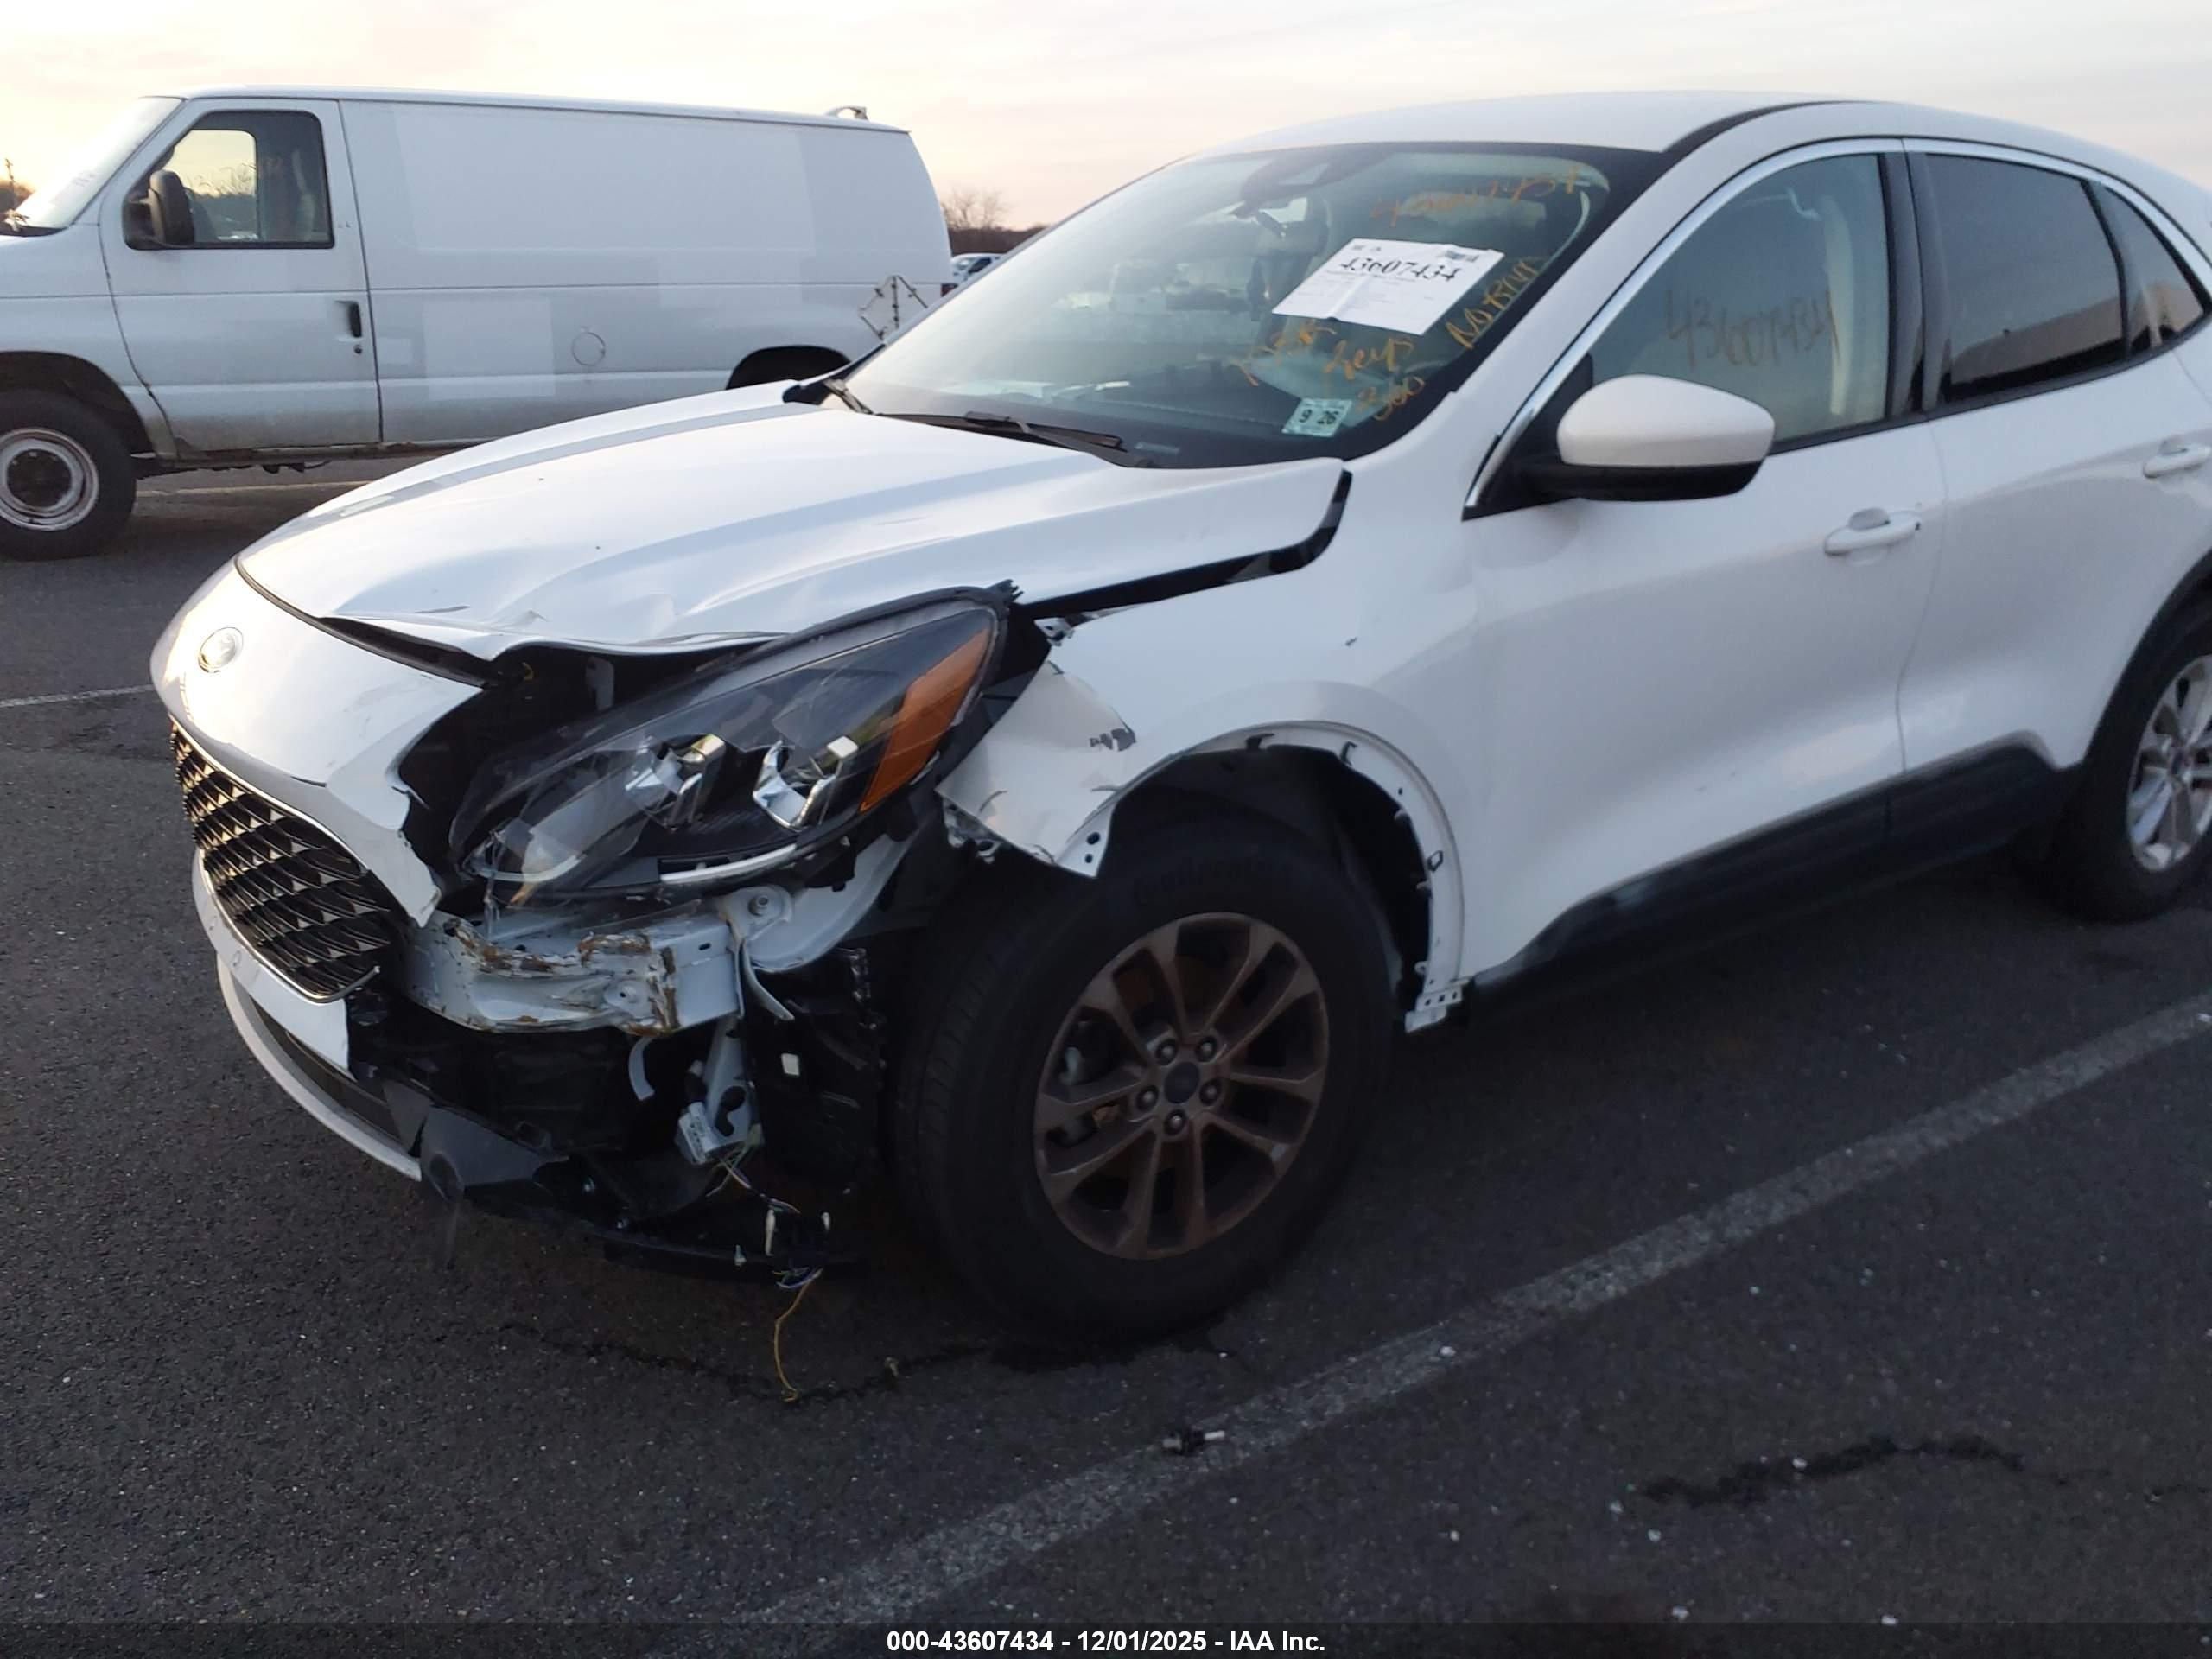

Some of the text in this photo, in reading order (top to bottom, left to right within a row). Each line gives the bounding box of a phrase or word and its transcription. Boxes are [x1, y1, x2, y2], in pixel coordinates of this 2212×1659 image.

[1339, 257, 1461, 283] 43607434
[1298, 409, 1339, 424] 9 26
